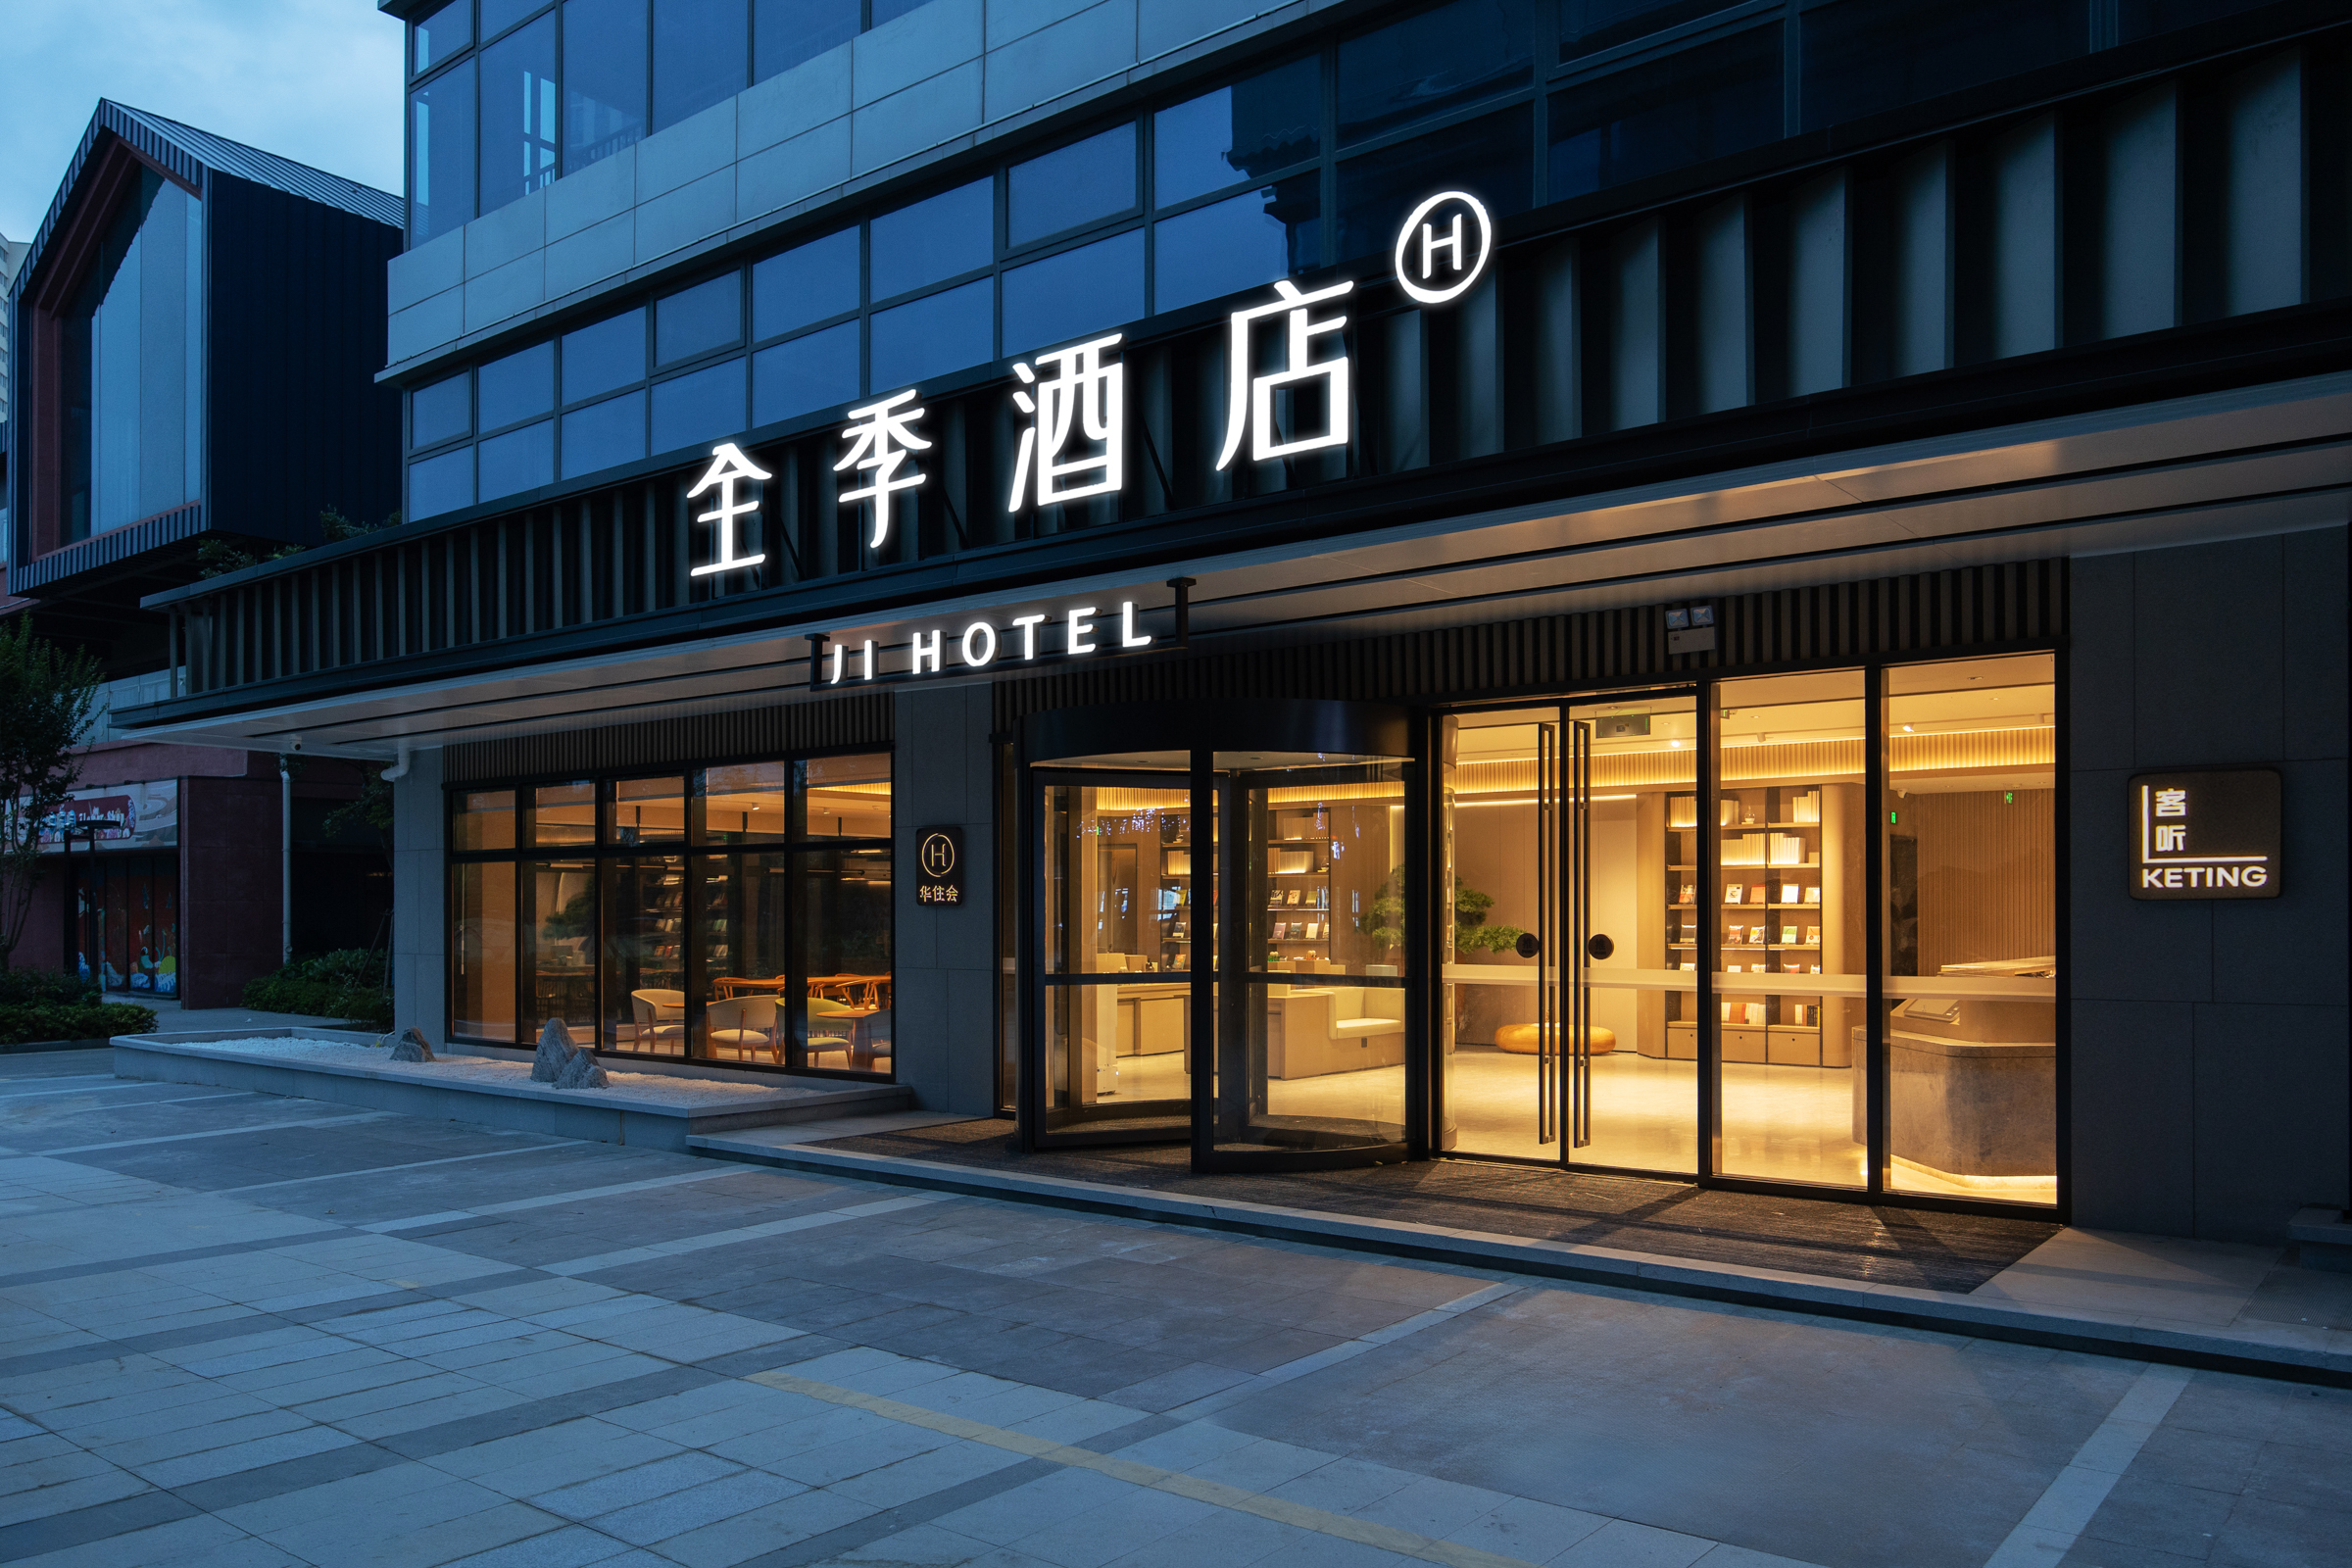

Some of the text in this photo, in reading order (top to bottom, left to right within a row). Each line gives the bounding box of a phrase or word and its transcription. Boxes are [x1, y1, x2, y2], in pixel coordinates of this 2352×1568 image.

[686, 279, 1355, 577] 全季酒店
[830, 601, 1152, 684] JI HOTEL
[919, 884, 958, 903] 华住会
[2141, 865, 2269, 889] KETING
